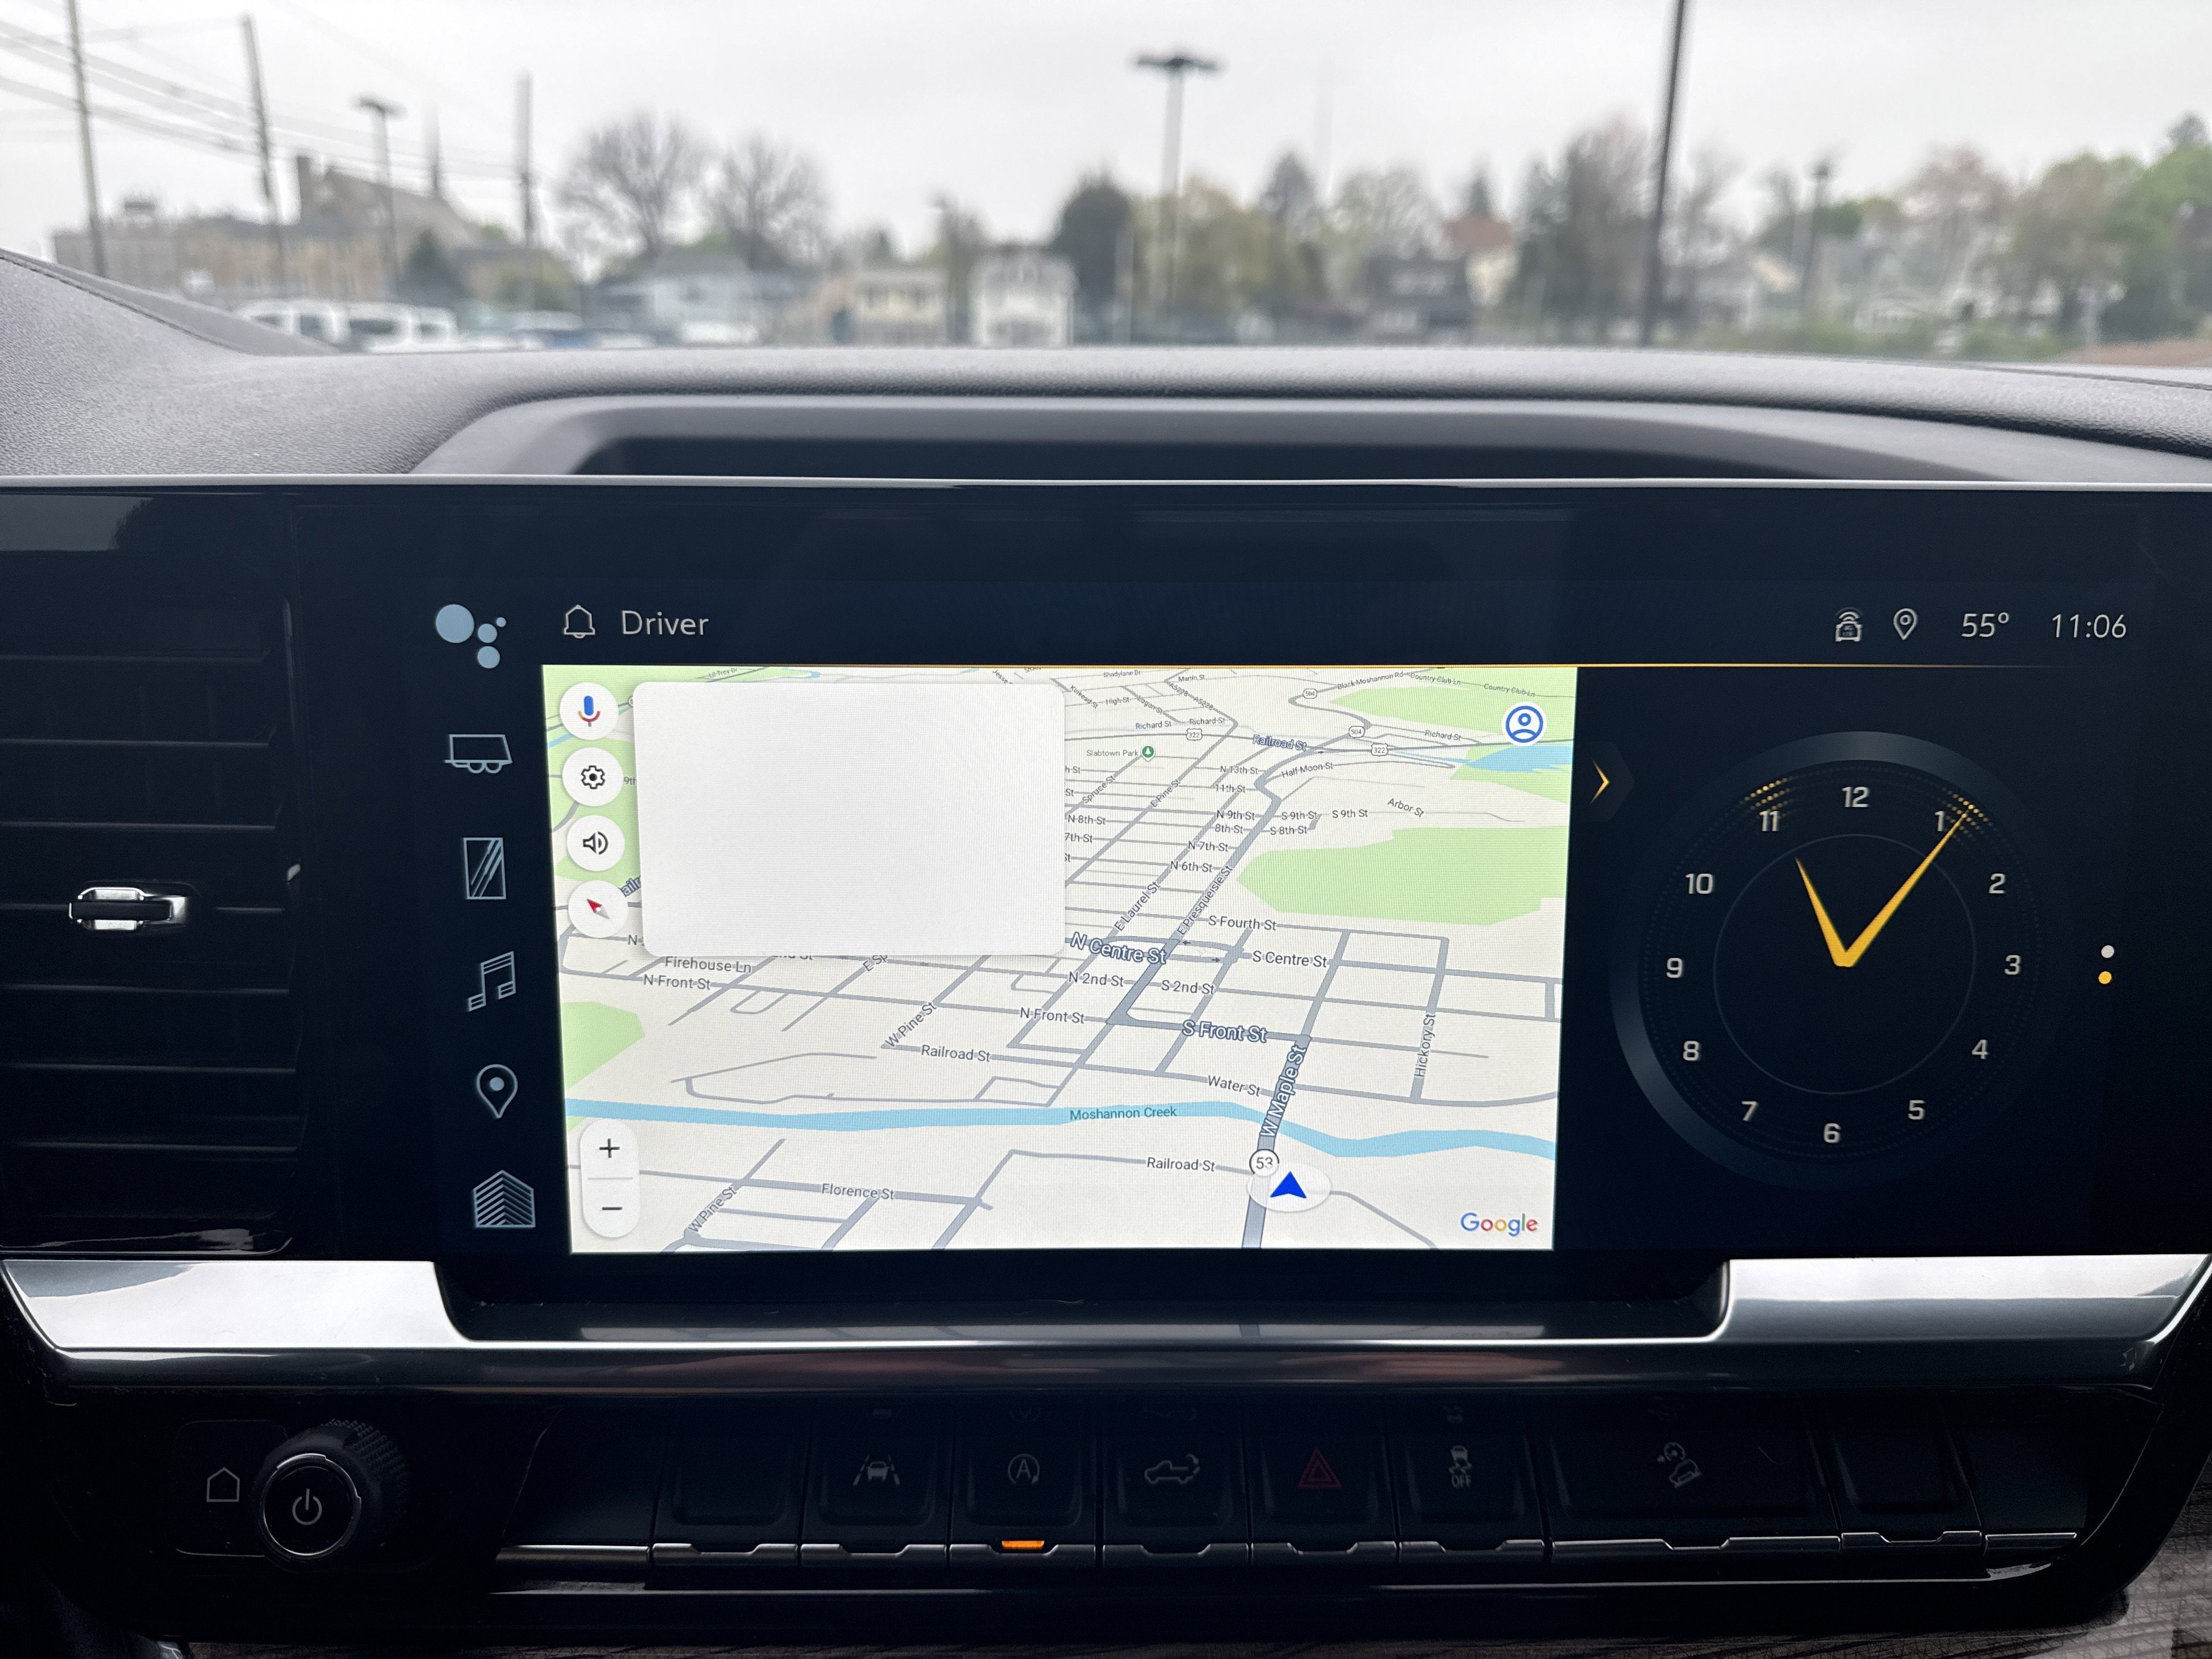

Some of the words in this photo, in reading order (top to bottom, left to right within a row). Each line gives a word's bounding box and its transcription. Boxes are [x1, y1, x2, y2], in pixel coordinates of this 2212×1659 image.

[622, 610, 709, 635] Driver
[2052, 613, 2127, 639] 11:06
[1338, 680, 1355, 690] Black
[1356, 674, 1393, 685] Moshannon
[1410, 673, 1436, 682] Country
[1436, 676, 1452, 684] Club
[1483, 683, 1509, 693] Country
[1511, 687, 1526, 695] Club
[1105, 697, 1121, 706] High
[1155, 707, 1163, 715] St
[1136, 721, 1163, 730] Richard
[1253, 734, 1294, 750] Railroad
[1295, 741, 1307, 752] St
[1425, 730, 1452, 740] Richard
[1453, 733, 1462, 742] St
[1229, 766, 1248, 774] 13th
[1250, 767, 1259, 775] St
[1282, 767, 1299, 778] Half
[1299, 763, 1322, 775] Moon
[1323, 761, 1334, 770] St
[1065, 788, 1074, 797] St
[1082, 783, 1107, 804] Spruce
[1106, 775, 1116, 785] St
[1150, 799, 1158, 808] E
[1156, 788, 1173, 803] Pine
[1171, 778, 1181, 788] St
[1216, 785, 1233, 793] 11th
[1235, 785, 1246, 793] St
[1842, 786, 1869, 809] 12
[1227, 811, 1243, 820] 9th
[1245, 812, 1256, 821] St
[1289, 811, 1306, 820] 9th
[1308, 811, 1318, 820] St
[1332, 810, 1339, 819] S
[1340, 810, 1356, 819] 9th
[1358, 809, 1368, 818] St
[1387, 797, 1414, 813] Arbor
[1413, 807, 1425, 818] St
[1067, 815, 1075, 823] N
[1077, 815, 1093, 823] 8th
[1096, 816, 1106, 825] St
[1759, 810, 1779, 832] 11
[1934, 810, 1946, 832] 1
[1064, 832, 1080, 842] 7th
[1083, 834, 1093, 843] St
[1215, 824, 1232, 833] 8th
[1233, 825, 1244, 834] St
[1270, 827, 1277, 836] S
[1279, 826, 1295, 835] 8th
[1297, 825, 1308, 834] St
[1188, 840, 1196, 850] N
[1199, 840, 1216, 850] 7th
[1217, 842, 1229, 852] St
[1170, 860, 1179, 870] N
[1181, 861, 1199, 871] 6th
[1201, 862, 1212, 873] St
[1685, 873, 1714, 895] 10
[1988, 873, 2006, 895] 2
[1114, 921, 1125, 932] E
[1121, 891, 1150, 923] Laurel
[1147, 881, 1161, 894] St
[1177, 925, 1187, 935] E
[1182, 876, 1225, 928] Presqueisle
[1221, 865, 1233, 877] St
[1208, 915, 1217, 926] S
[1220, 916, 1260, 930] Fourth
[1263, 918, 1277, 931] St
[628, 934, 638, 945] N
[1070, 931, 1087, 950] N
[1089, 938, 1144, 963] Centre
[1147, 947, 1167, 964] St
[664, 956, 732, 972] Firehouse
[735, 961, 752, 973] Ln
[862, 960, 874, 972] E
[1252, 950, 1262, 962] S
[1263, 951, 1309, 967] Centre
[1312, 955, 1328, 968] St
[2004, 954, 2021, 976] 3
[1666, 957, 1684, 979] 9
[643, 973, 654, 986] N
[658, 974, 693, 989] Front
[697, 978, 711, 990] St
[1068, 972, 1079, 983] N
[1081, 973, 1109, 986] 2nd
[1111, 975, 1124, 988] St
[1161, 980, 1170, 991] S
[1173, 980, 1199, 994] 2nd
[1201, 983, 1215, 995] St
[1020, 1007, 1031, 1019] N
[1034, 1008, 1068, 1023] Front
[1071, 1012, 1085, 1024] St
[1423, 1012, 1437, 1026] St
[884, 1034, 900, 1048] W
[898, 1013, 925, 1039] Pine
[921, 1001, 938, 1017] St
[1182, 1019, 1197, 1036] S
[1199, 1021, 1245, 1042] Front
[1246, 1025, 1267, 1043] St
[921, 1044, 974, 1062] Railroad
[977, 1050, 991, 1062] St
[1415, 1027, 1436, 1078] Hickory
[1683, 1040, 1701, 1062] 8
[1971, 1039, 1989, 1060] 4
[1207, 1075, 1244, 1092] Water
[1245, 1084, 1261, 1097] St
[1260, 1119, 1279, 1138] W
[1270, 1066, 1299, 1119] Maple
[1286, 1043, 1307, 1065] St
[1069, 1108, 1140, 1121] Moshannon
[1144, 1106, 1177, 1118] Creek
[1741, 1101, 1758, 1122] 7
[1908, 1099, 1926, 1121] 5
[1823, 1122, 1841, 1144] 6
[1147, 1157, 1199, 1171] Railroad
[1202, 1160, 1215, 1172] St
[1256, 1157, 1273, 1170] 53
[822, 1183, 878, 1199] Florence
[881, 1188, 895, 1200] St
[687, 1219, 703, 1233] W
[700, 1195, 726, 1222] Pine
[721, 1186, 737, 1200] St
[1460, 1211, 1538, 1237] Google
